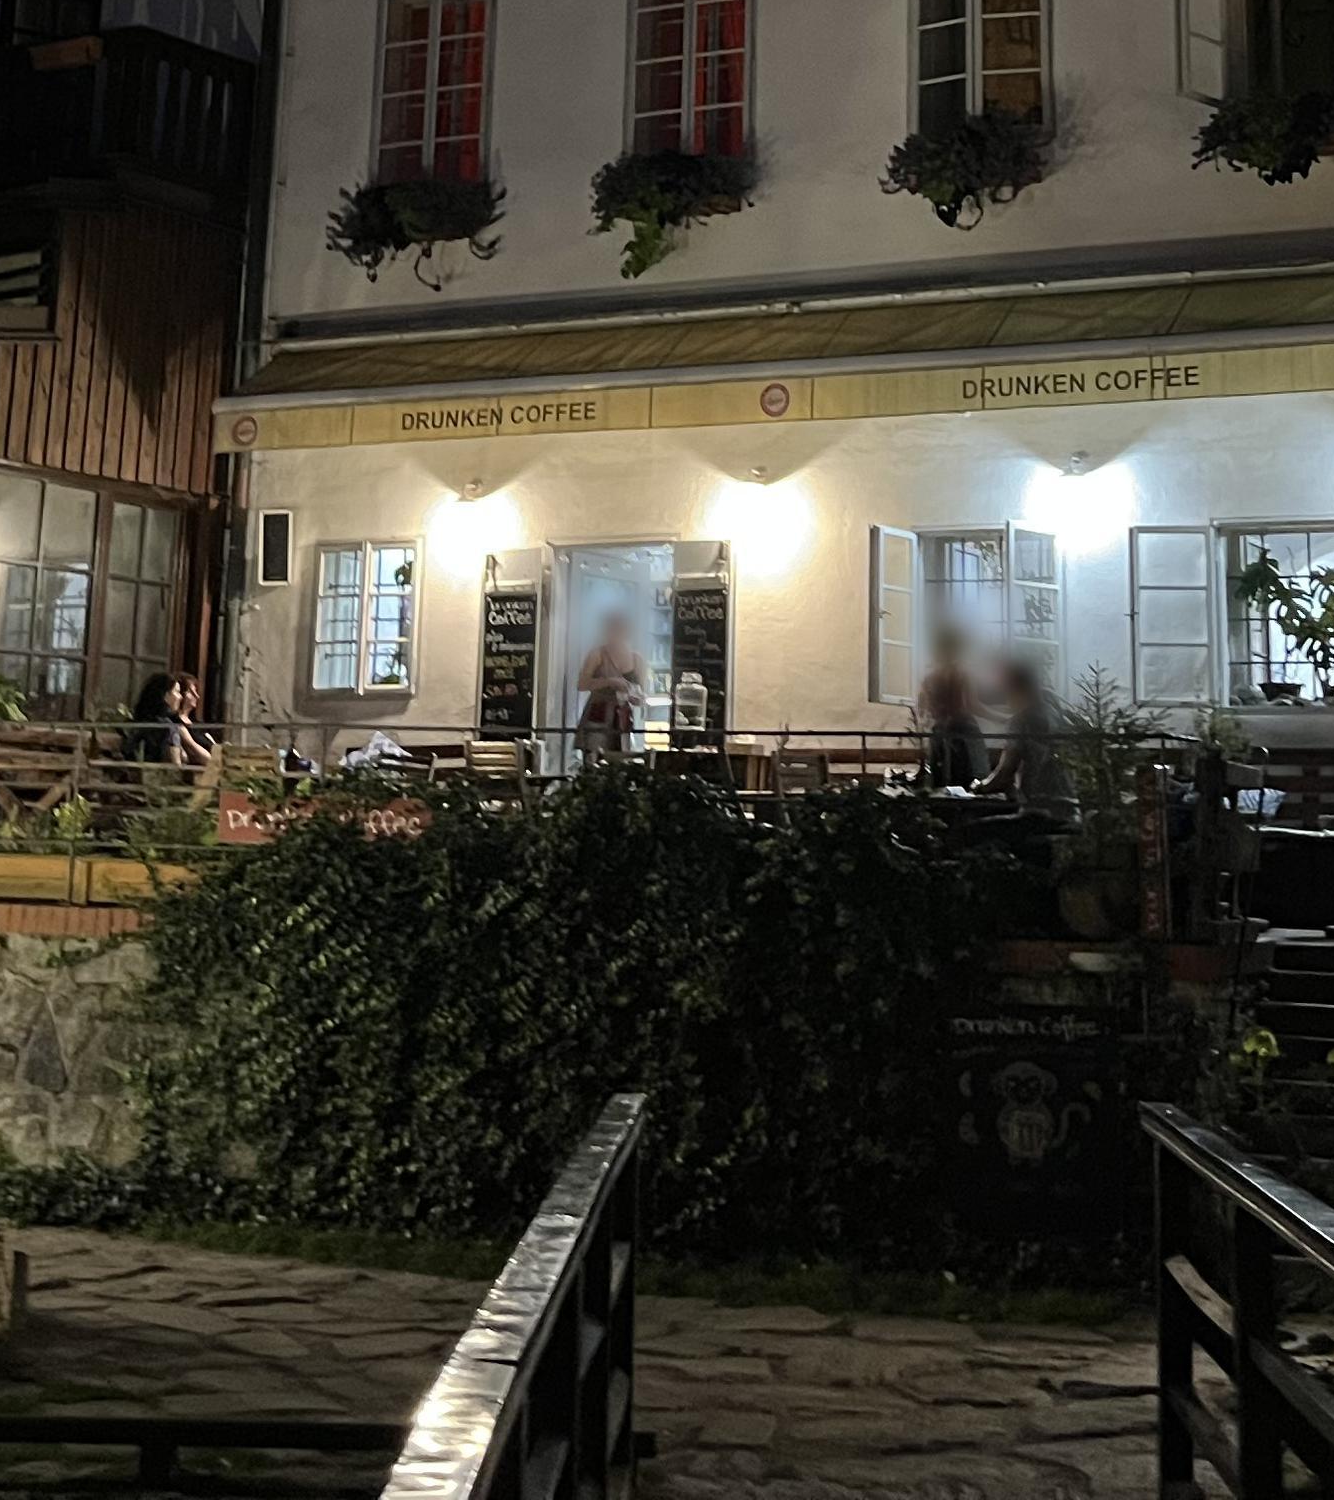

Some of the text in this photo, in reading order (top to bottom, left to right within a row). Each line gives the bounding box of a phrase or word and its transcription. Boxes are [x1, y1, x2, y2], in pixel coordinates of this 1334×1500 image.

[962, 365, 1201, 399] DRUNKEN COFFEE
[401, 401, 597, 431] DRUNKEN COFFEE
